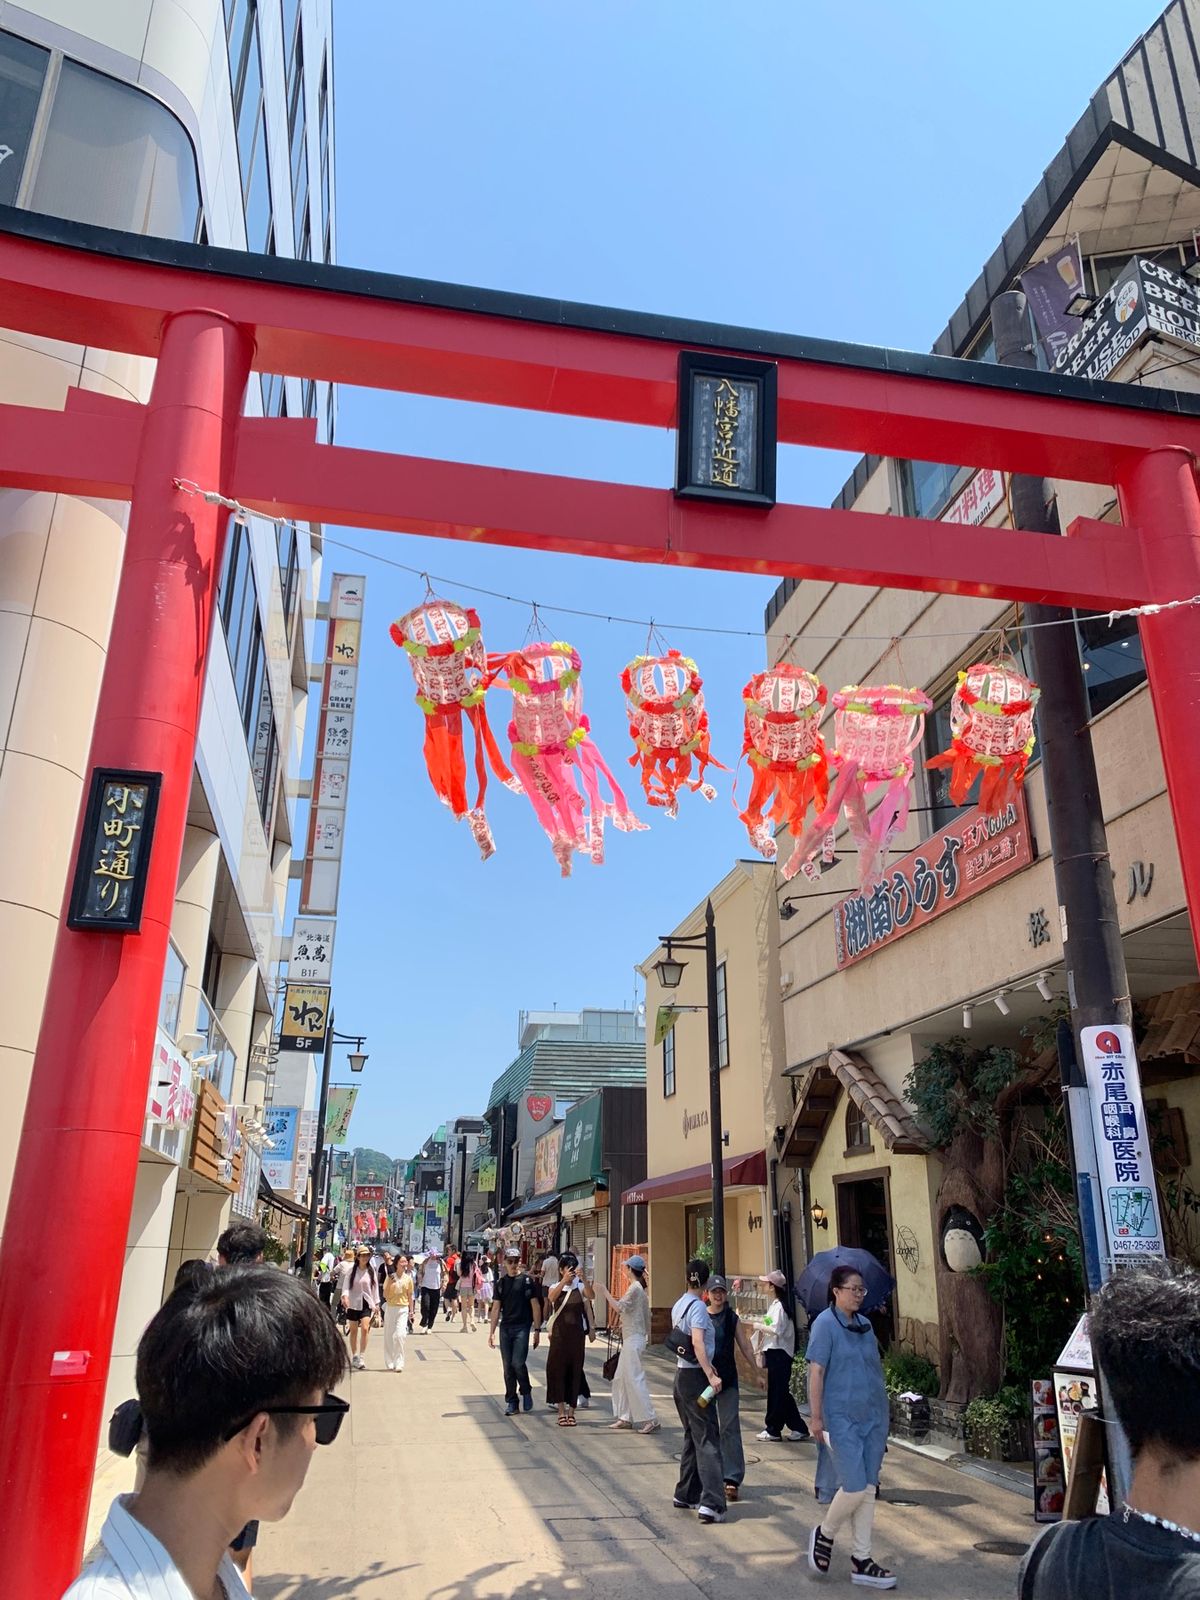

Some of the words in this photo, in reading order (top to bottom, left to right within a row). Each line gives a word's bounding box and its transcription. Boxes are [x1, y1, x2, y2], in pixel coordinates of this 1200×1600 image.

[1143, 280, 1200, 318] BEE
[711, 378, 741, 488] 八幡宮近道
[335, 643, 354, 658] わん
[329, 695, 353, 703] CRAFT
[334, 715, 345, 723] 3F
[94, 786, 143, 912] 小町通り
[306, 932, 330, 943] 北海道
[293, 944, 327, 963] 魚萬
[301, 968, 319, 978] B1F
[288, 1000, 323, 1033] わん
[295, 1037, 312, 1049] 5F
[1101, 1061, 1128, 1101] 赤尾
[1113, 1142, 1140, 1182] 医院
